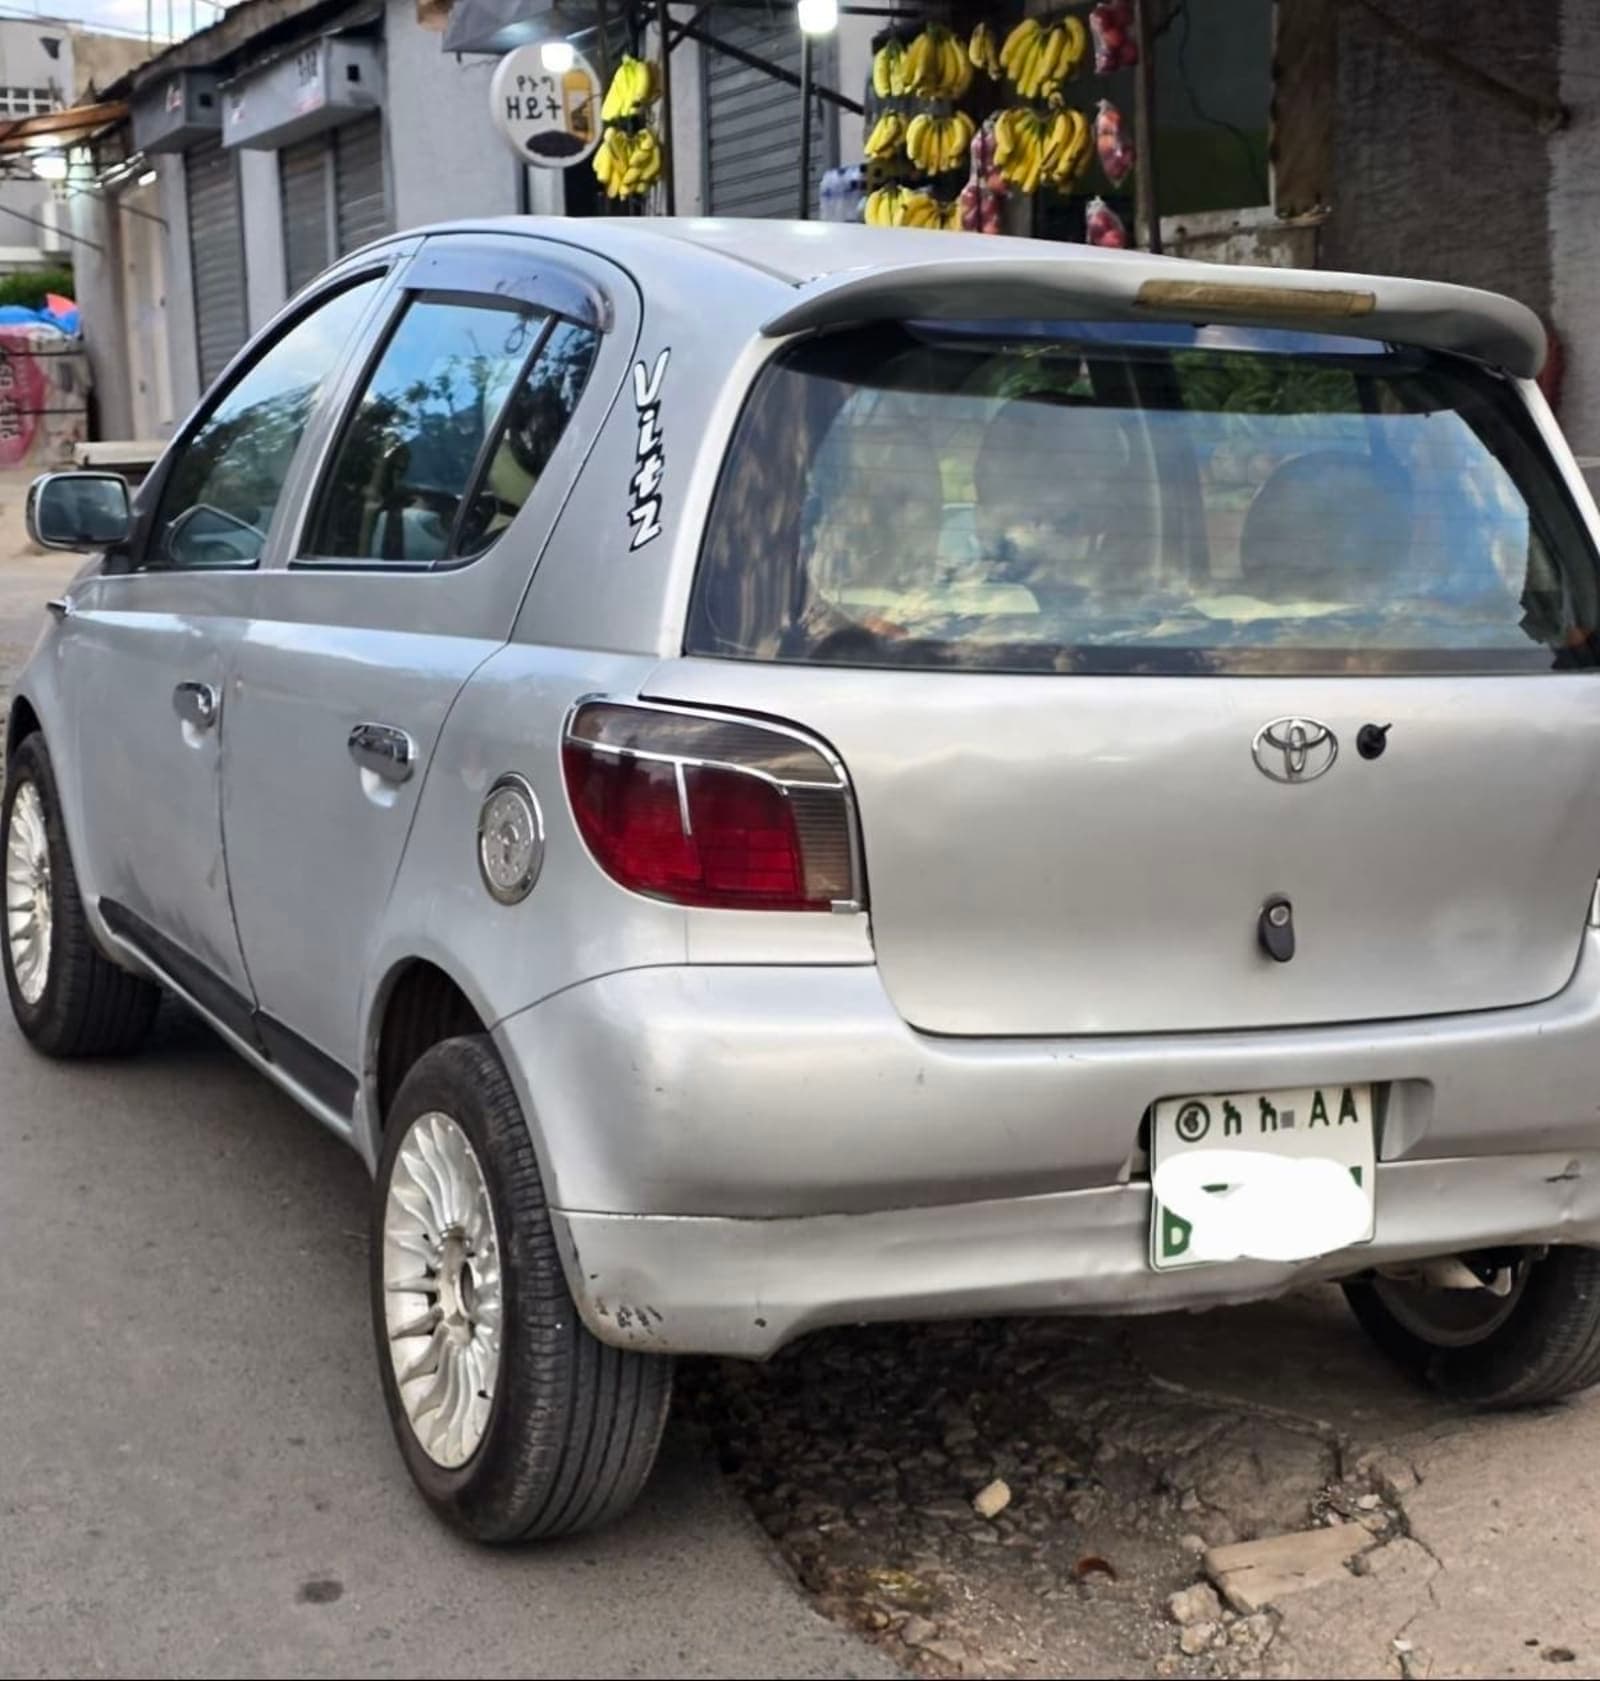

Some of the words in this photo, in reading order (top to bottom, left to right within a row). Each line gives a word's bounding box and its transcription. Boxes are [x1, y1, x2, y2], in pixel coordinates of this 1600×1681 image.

[507, 96, 562, 120] ዘይት
[627, 347, 672, 552] Vitz
[1308, 1088, 1358, 1128] AA
